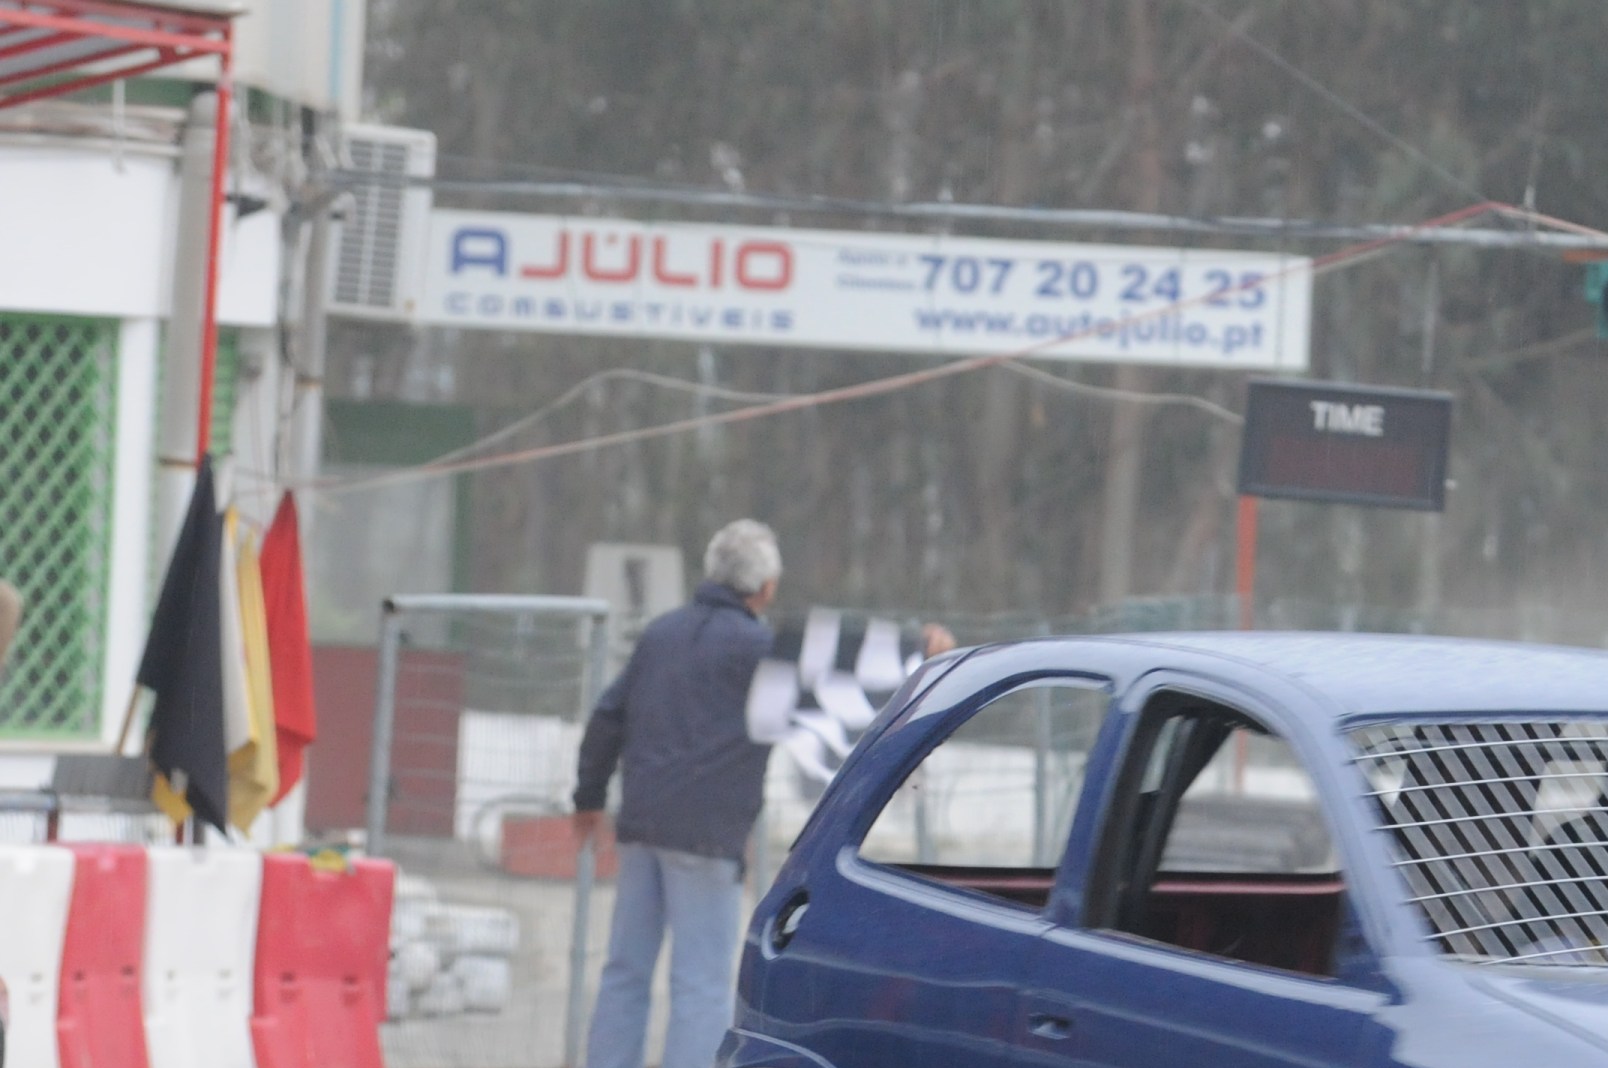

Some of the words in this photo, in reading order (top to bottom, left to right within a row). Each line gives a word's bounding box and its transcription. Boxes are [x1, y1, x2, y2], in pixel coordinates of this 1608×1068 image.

[919, 254, 1014, 294] 707
[1036, 262, 1098, 298] 20
[1120, 265, 1182, 301] 24
[1204, 269, 1265, 309] 25
[1309, 400, 1385, 437] TIME
